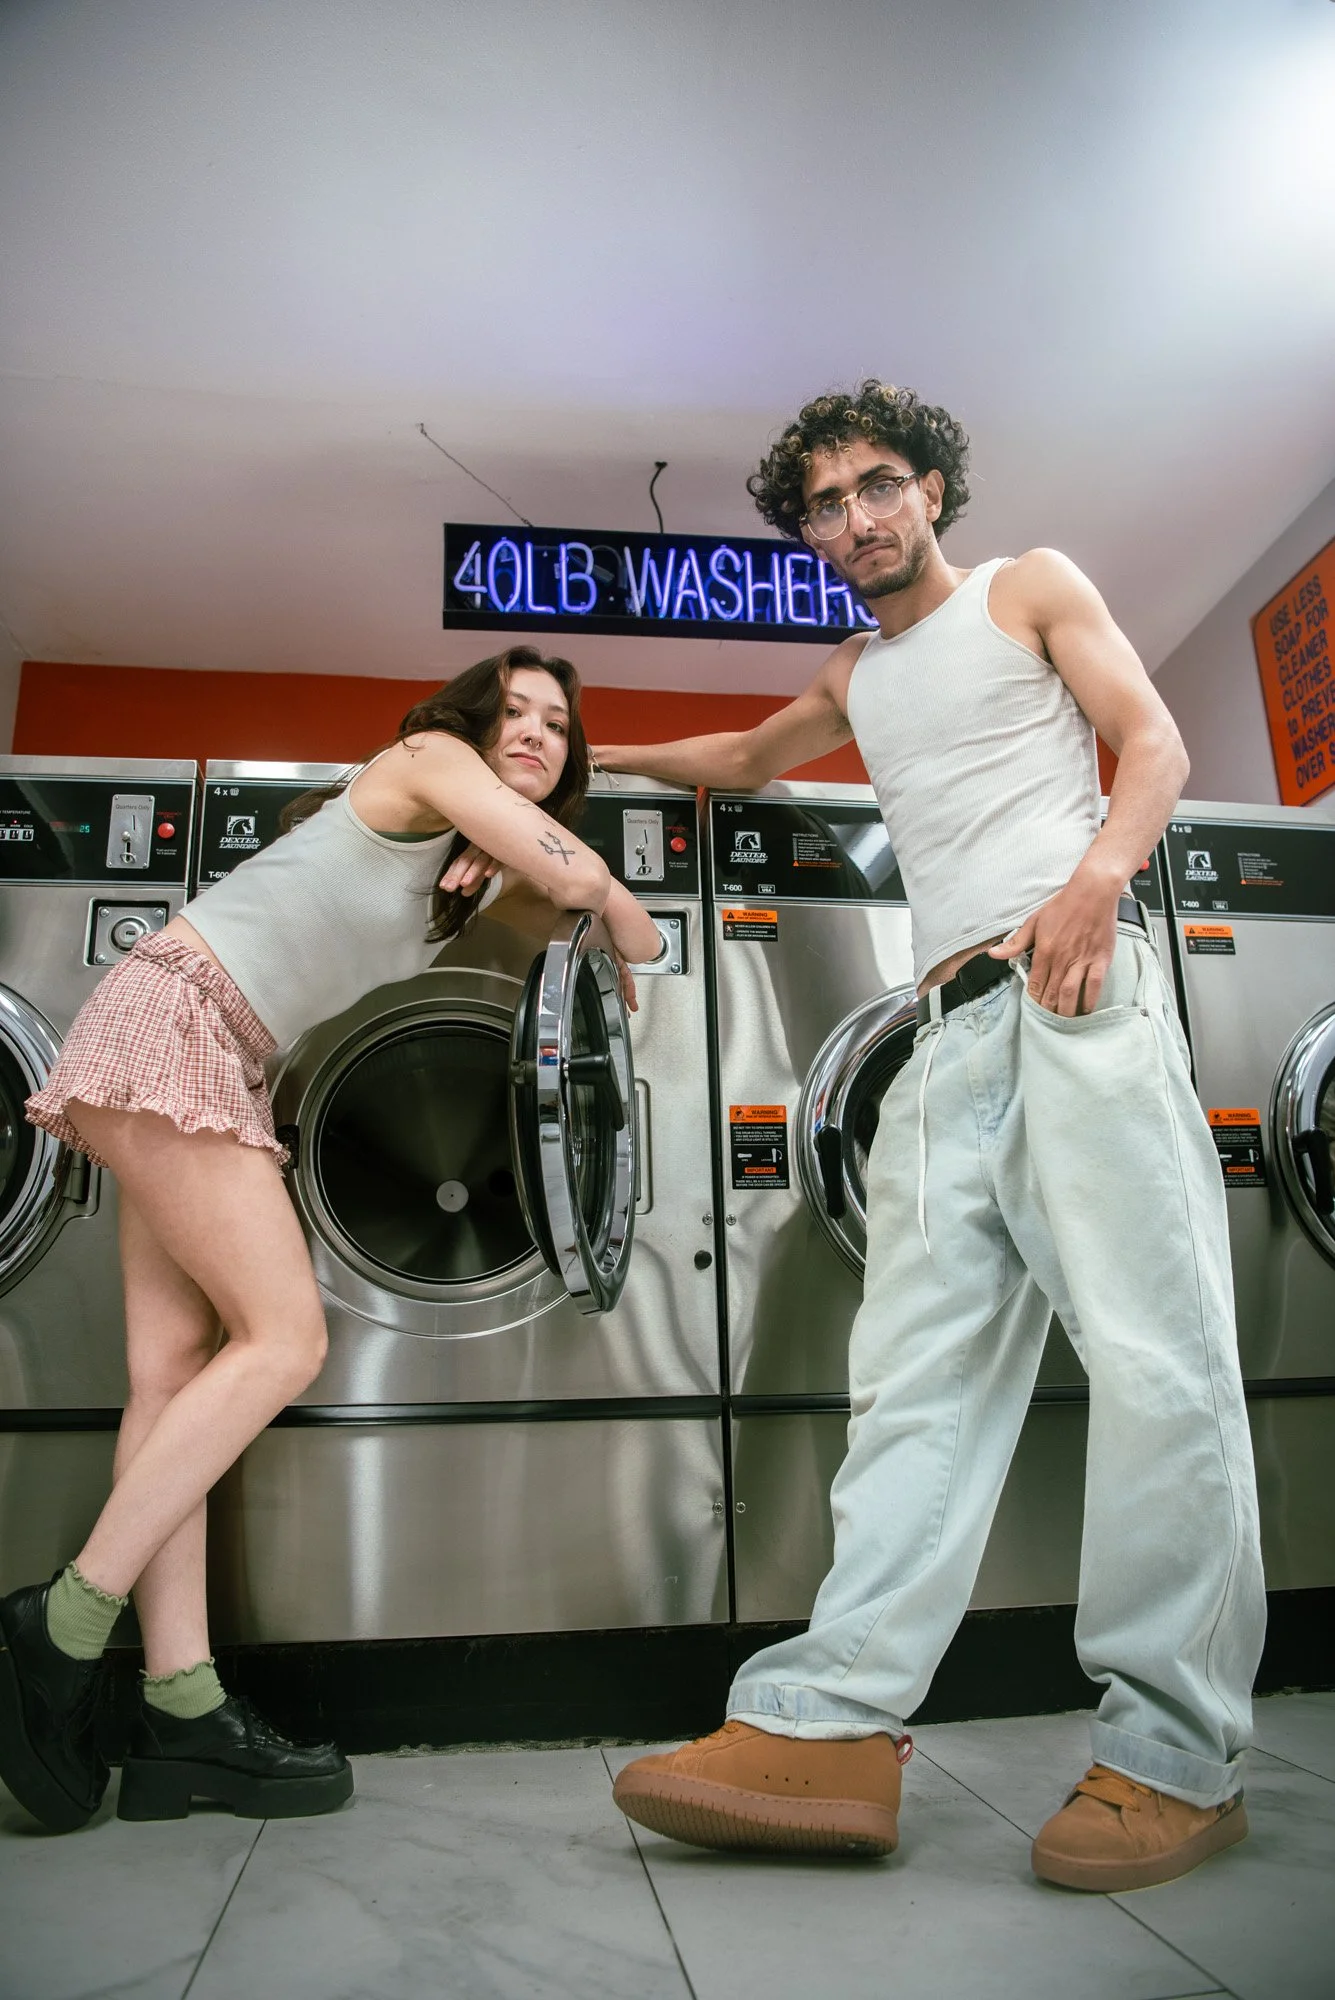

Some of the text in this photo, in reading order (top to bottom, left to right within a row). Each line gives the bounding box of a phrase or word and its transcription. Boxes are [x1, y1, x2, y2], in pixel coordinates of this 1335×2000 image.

[1270, 574, 1322, 636] USE LESS
[1275, 598, 1329, 661] SOAP FOR
[1279, 629, 1328, 686] CLEANER
[1283, 655, 1331, 712] CLOTHES
[1296, 751, 1326, 788] OVER
[214, 787, 221, 796] 4
[720, 803, 726, 812] 4
[730, 851, 767, 859] DEXTER
[722, 884, 743, 892] T-600
